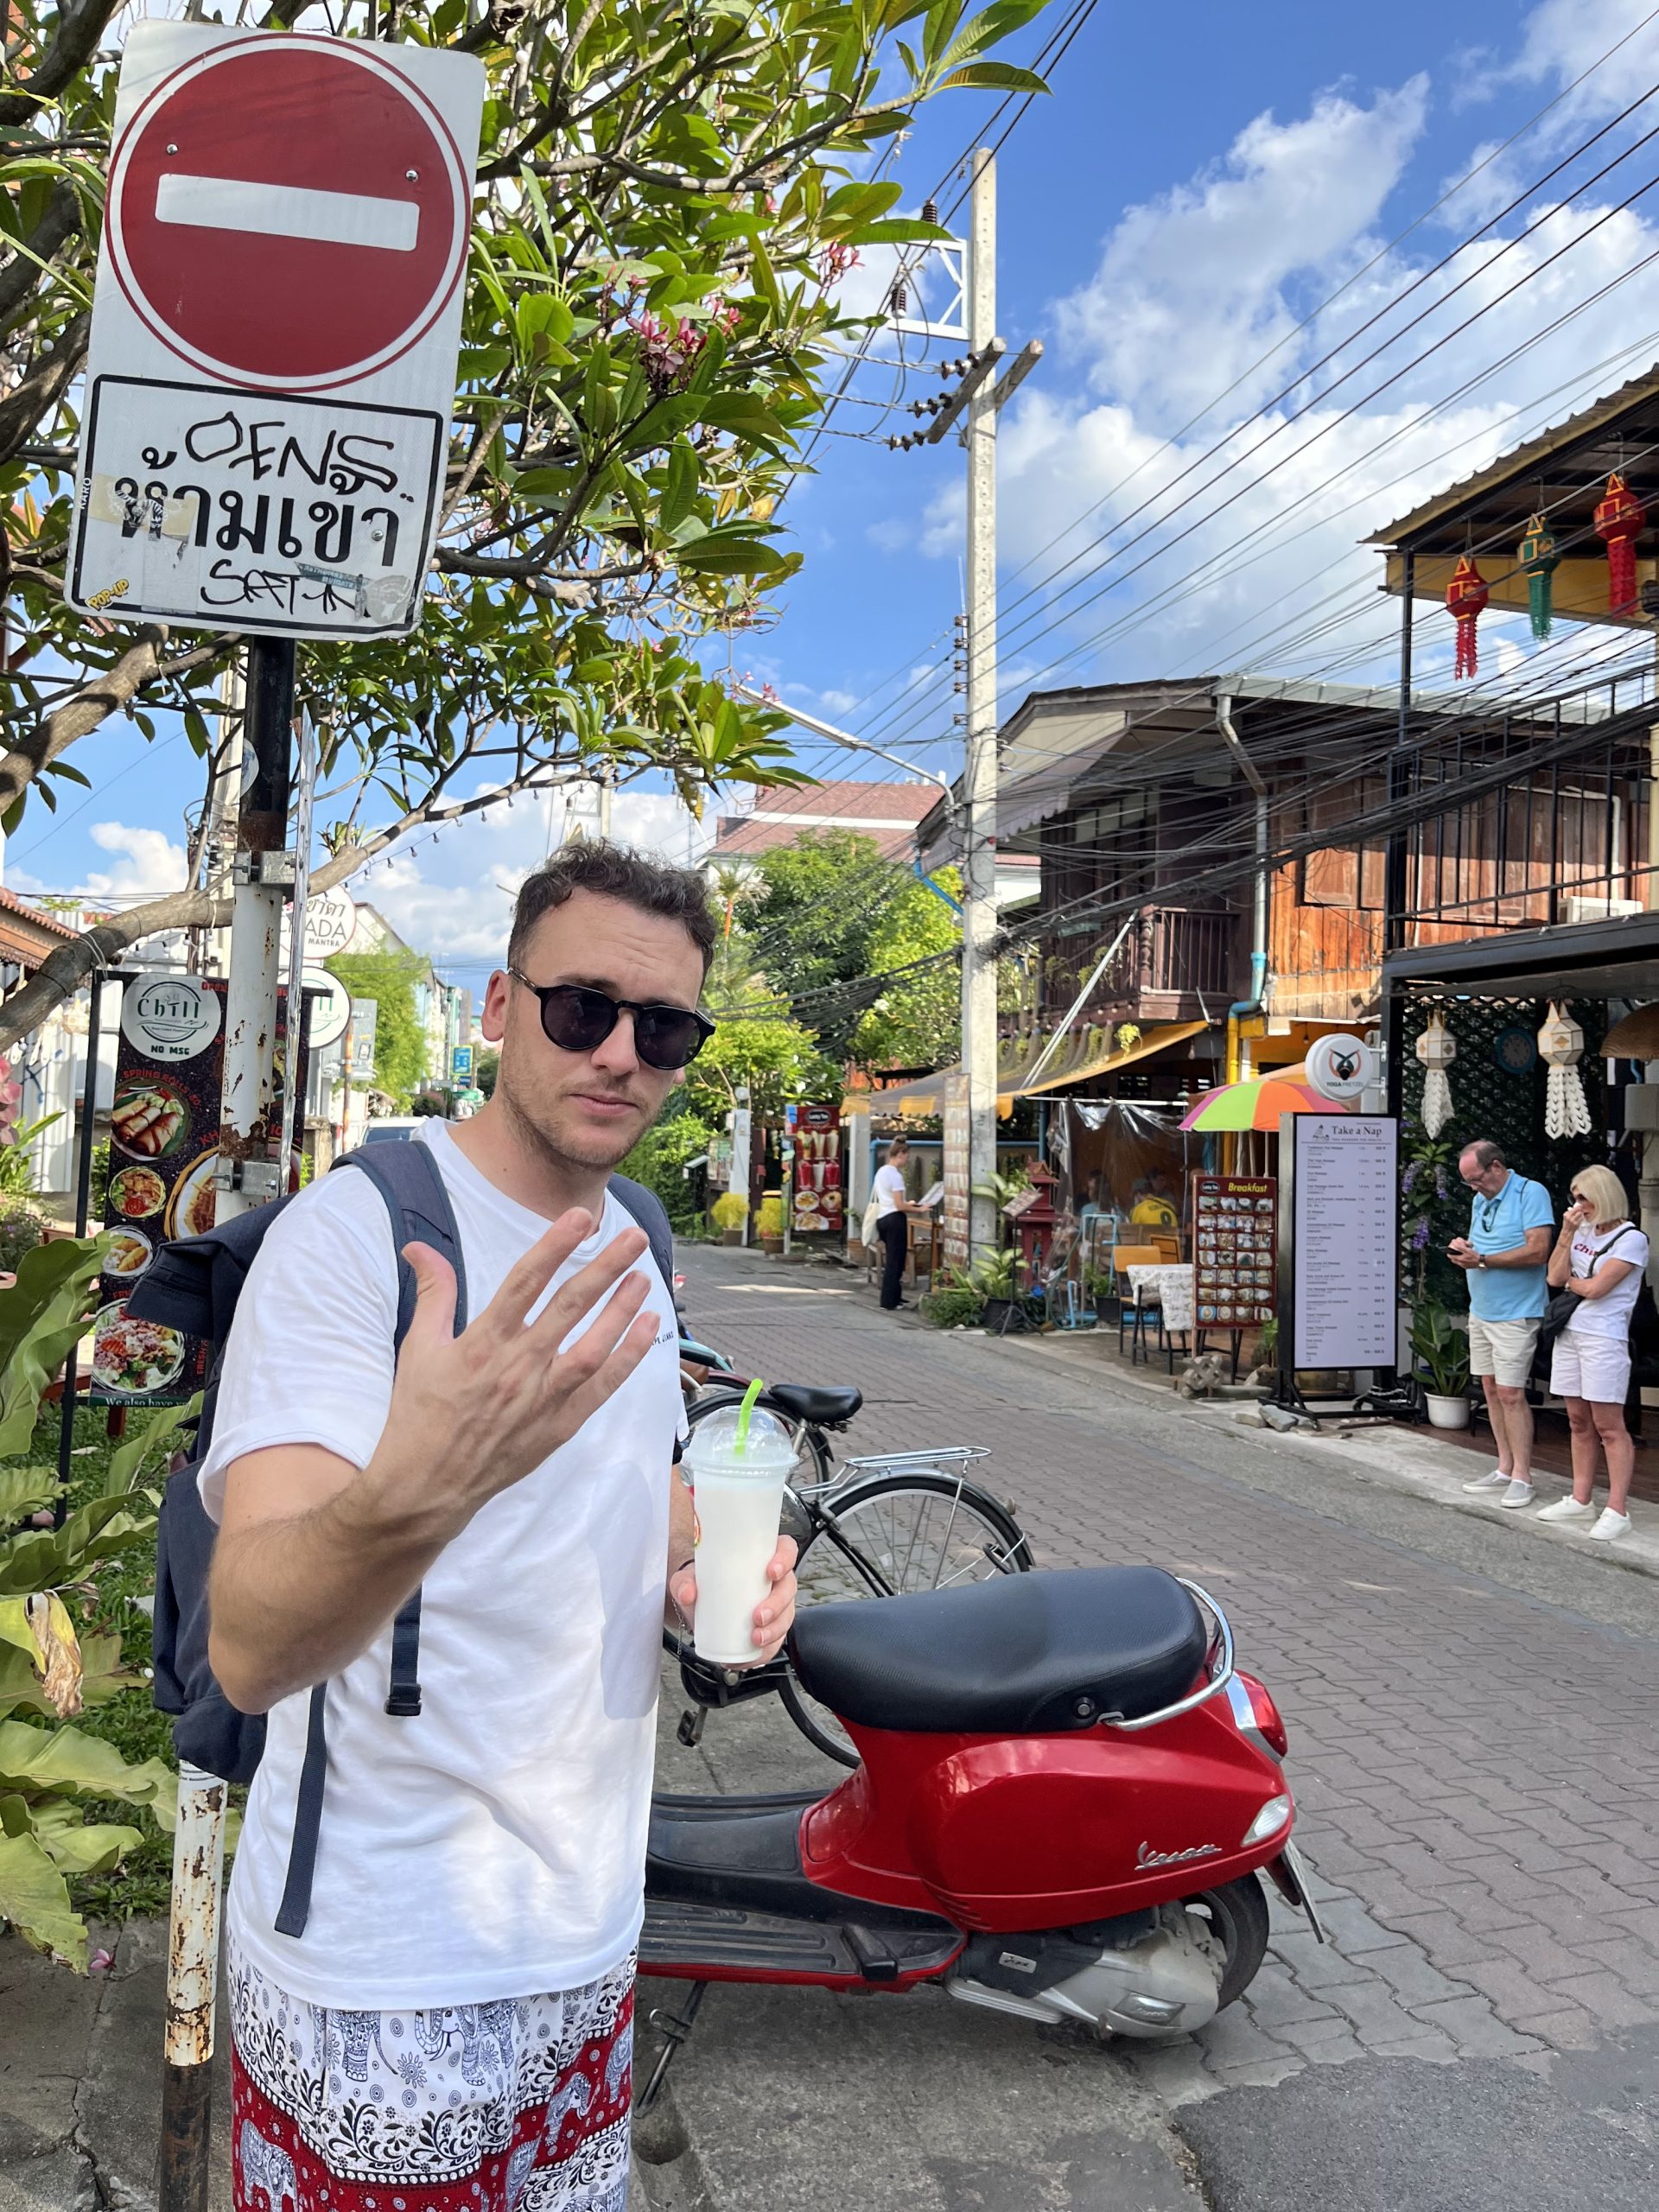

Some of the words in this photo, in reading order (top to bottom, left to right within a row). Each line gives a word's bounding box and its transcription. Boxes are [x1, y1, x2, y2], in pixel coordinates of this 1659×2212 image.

[115, 446, 400, 567] ห้ามเข้า
[88, 578, 130, 611] POP-UP
[308, 938, 340, 947] MANTRA
[150, 1045, 164, 1054] NO
[169, 1046, 190, 1055] MSG
[123, 1069, 161, 1079] SPRING
[1332, 1125, 1354, 1135] Take
[1363, 1126, 1382, 1138] Nap
[1228, 1182, 1268, 1193] Breakfast
[105, 1397, 122, 1406] We
[124, 1397, 145, 1406] also
